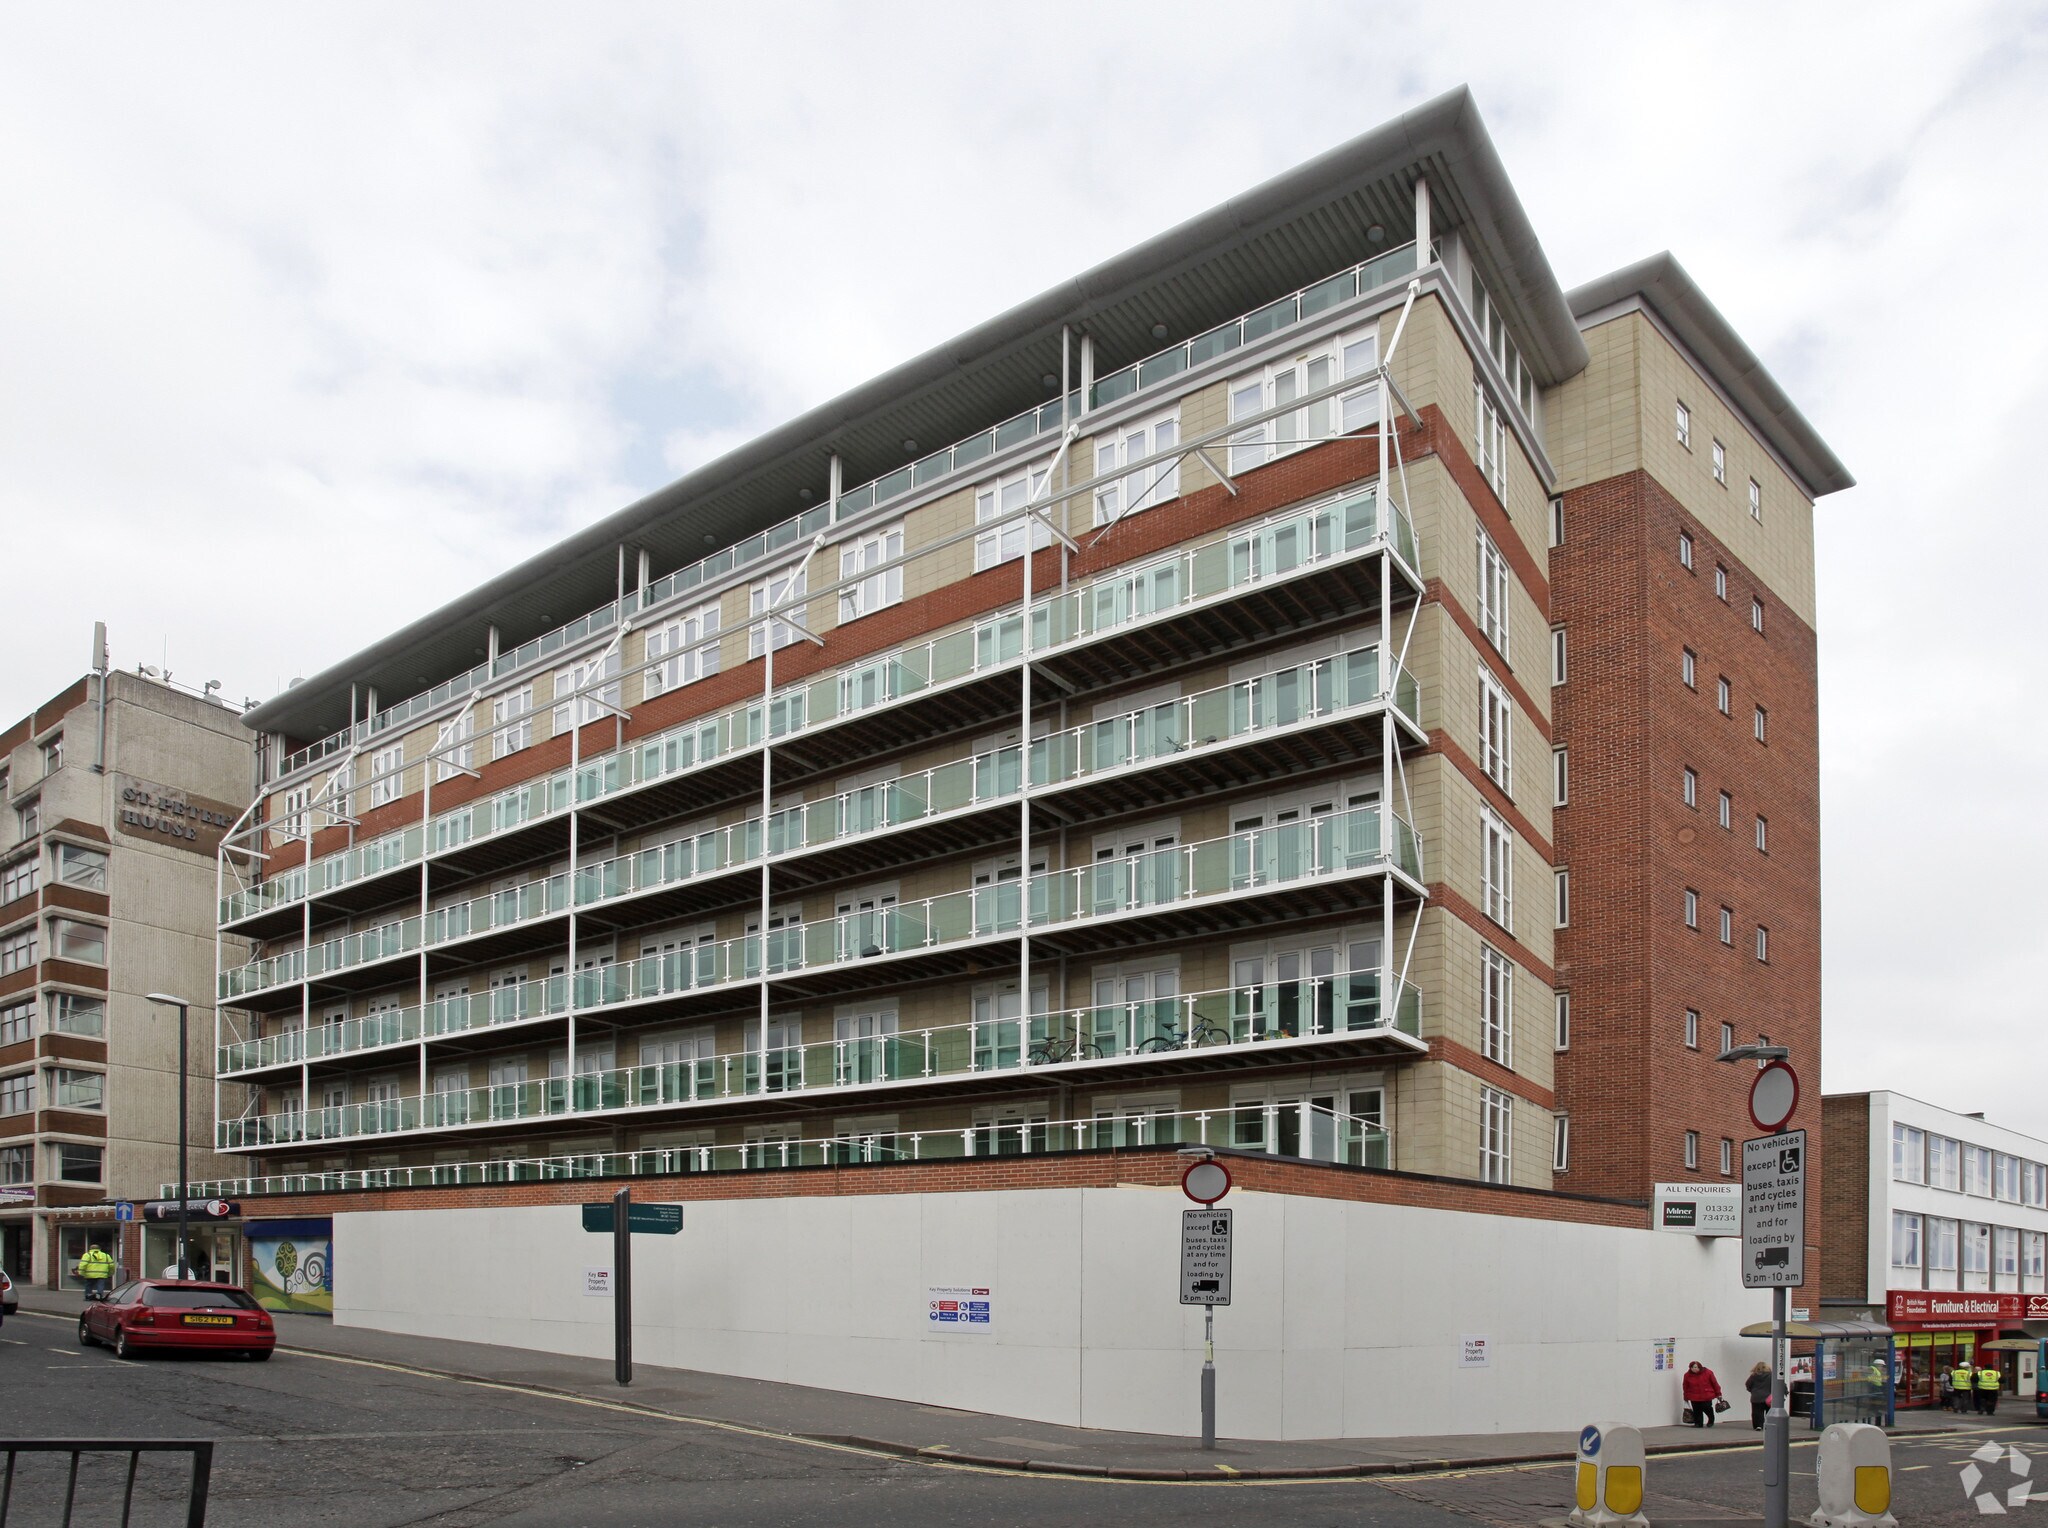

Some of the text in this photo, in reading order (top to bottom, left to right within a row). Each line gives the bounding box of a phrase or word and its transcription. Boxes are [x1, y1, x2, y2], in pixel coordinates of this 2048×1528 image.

[122, 787, 155, 807] ST.
[122, 809, 197, 841] HOUSE
[1747, 1135, 1800, 1152] No vehicles
[1746, 1159, 1777, 1172] except
[1776, 1176, 1800, 1187] taxis
[1684, 1186, 1732, 1194] ENQUIRIES
[1749, 1189, 1797, 1202] and cycles
[1666, 1207, 1693, 1215] Milner
[1748, 1200, 1798, 1214] at any time
[1702, 1214, 1736, 1222] 734734
[1756, 1217, 1789, 1229] and for
[1749, 1233, 1796, 1245] loading by
[1187, 1271, 1214, 1279] loading
[1745, 1273, 1752, 1282] 5
[1753, 1275, 1767, 1284] pm
[1771, 1272, 1783, 1282] 10
[1784, 1273, 1799, 1282] am
[588, 1278, 607, 1286] Property
[1906, 1306, 1927, 1314] Foundation
[1931, 1300, 2000, 1314] Furniture & Electrical
[1465, 1347, 1484, 1355] Property
